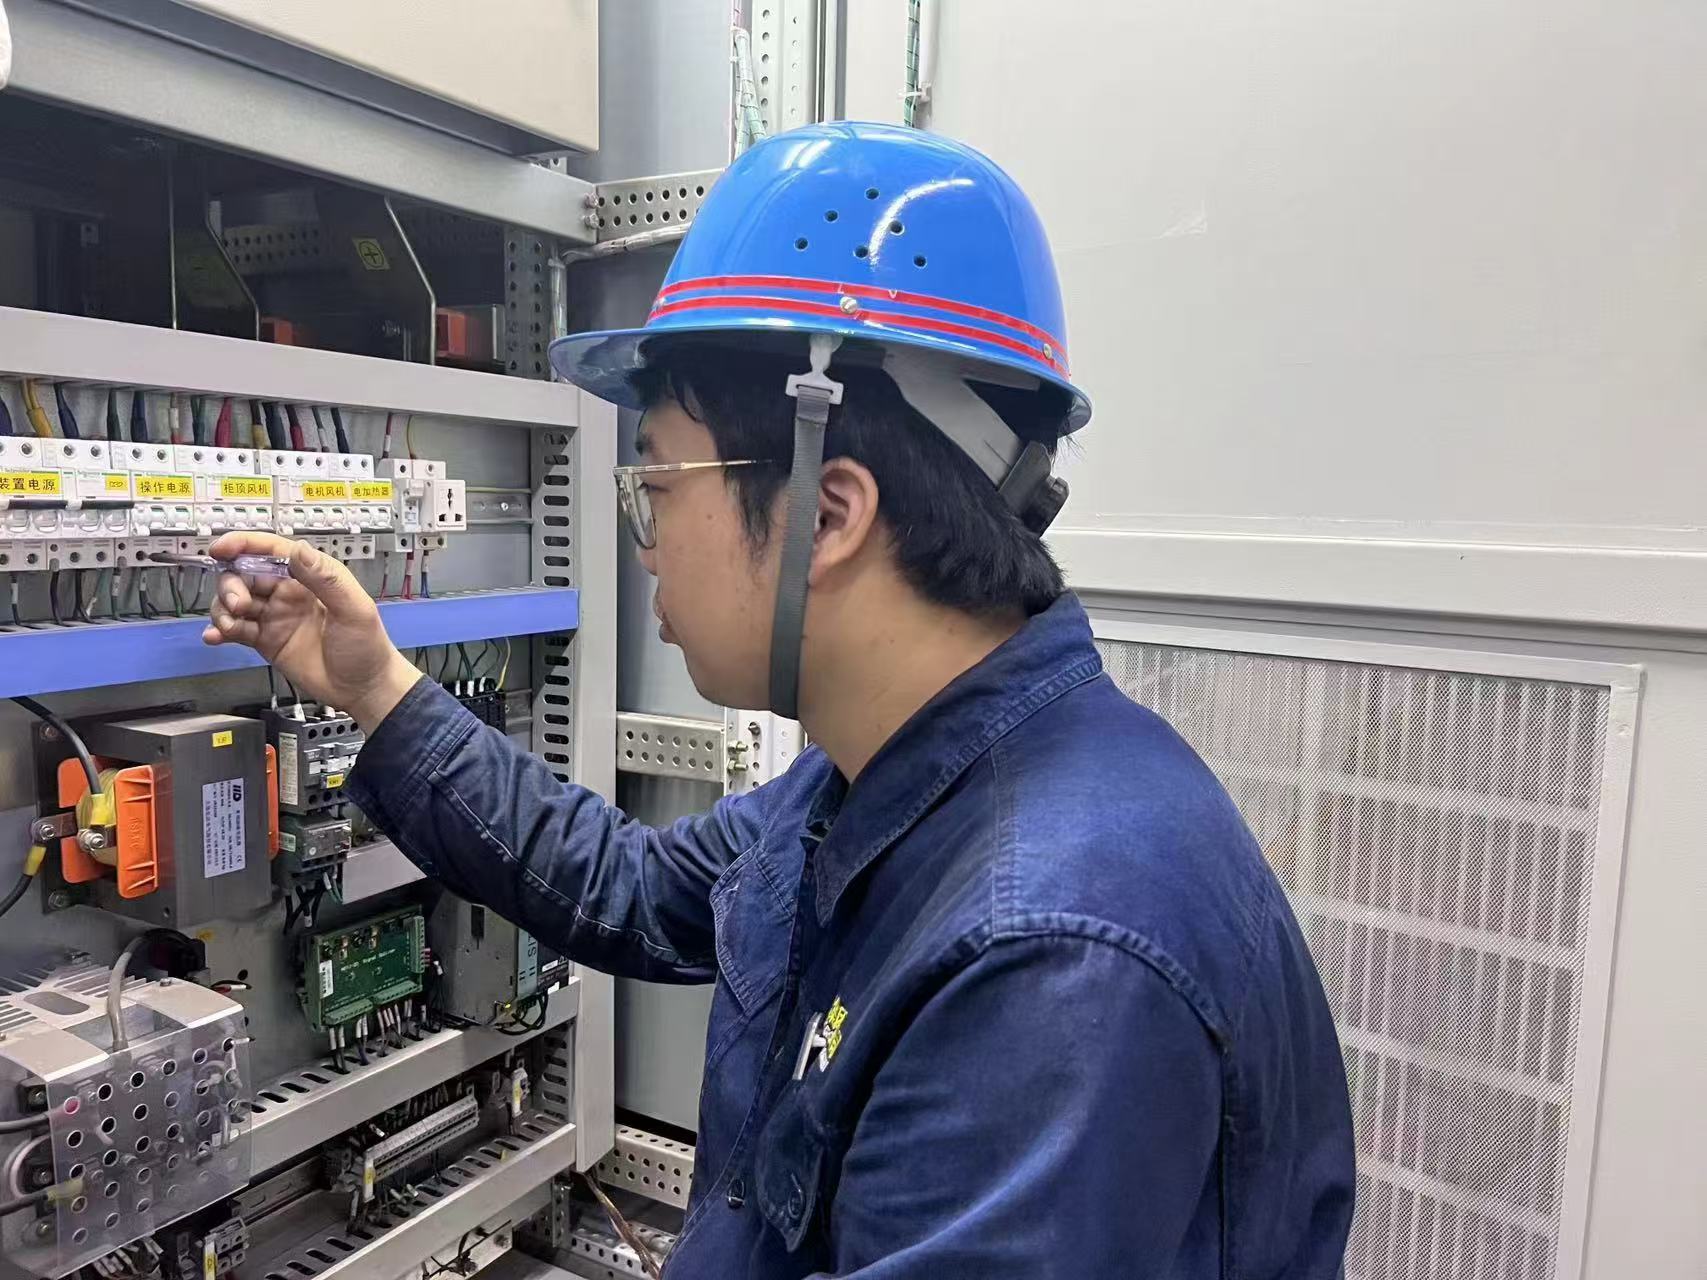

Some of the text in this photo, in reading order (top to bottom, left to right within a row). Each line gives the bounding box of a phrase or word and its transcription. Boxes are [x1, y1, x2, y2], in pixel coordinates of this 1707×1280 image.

[0, 477, 55, 490] 装置电源
[140, 481, 190, 493] 操作电源
[224, 483, 269, 494] 柜顶风机
[305, 486, 345, 496] 电机风机
[353, 487, 389, 496] 电加热器
